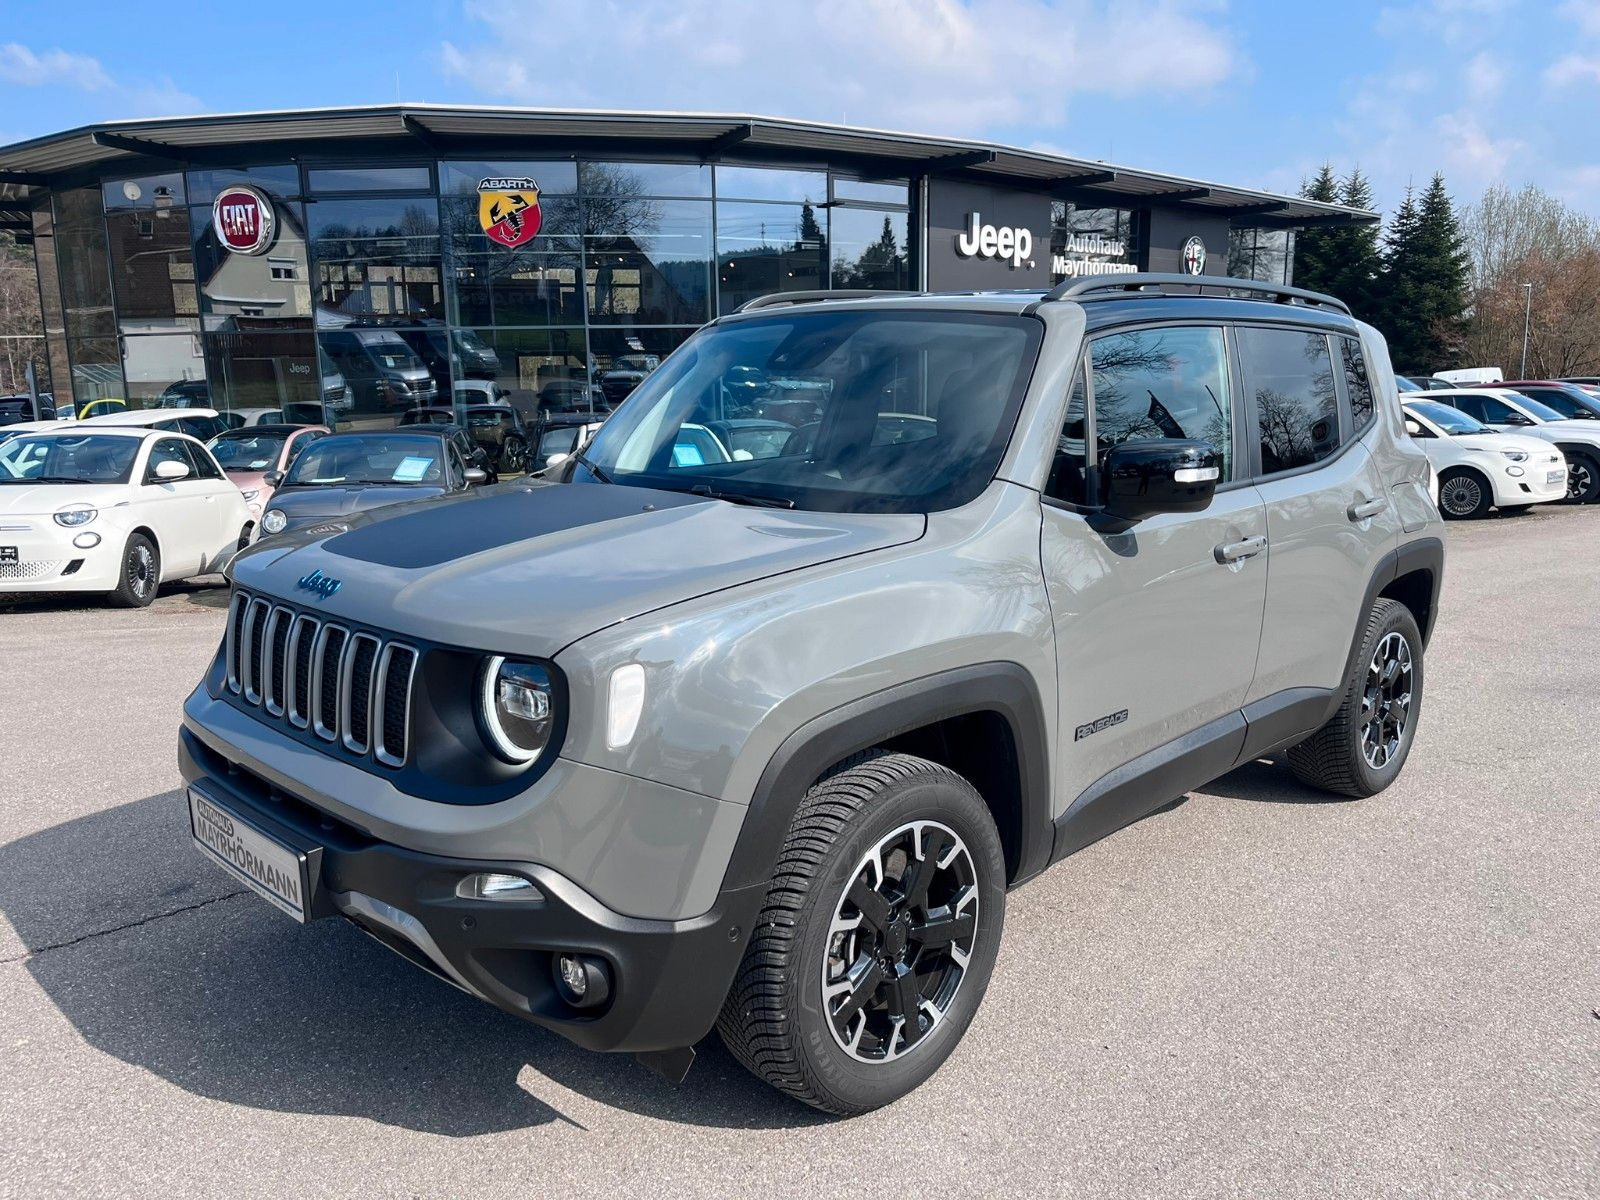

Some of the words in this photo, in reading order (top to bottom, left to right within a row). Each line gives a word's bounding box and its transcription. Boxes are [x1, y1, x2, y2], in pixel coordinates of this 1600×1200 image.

[481, 180, 534, 188] ABARTH
[222, 204, 255, 236] FIAT
[1066, 233, 1125, 256] Autohaus
[289, 363, 310, 375] Jeep
[297, 569, 342, 600] Jeep
[1074, 708, 1128, 742] RENEGADE
[200, 801, 234, 836] AUTOHAUS
[197, 819, 299, 904] MAYRHÖRMANN
